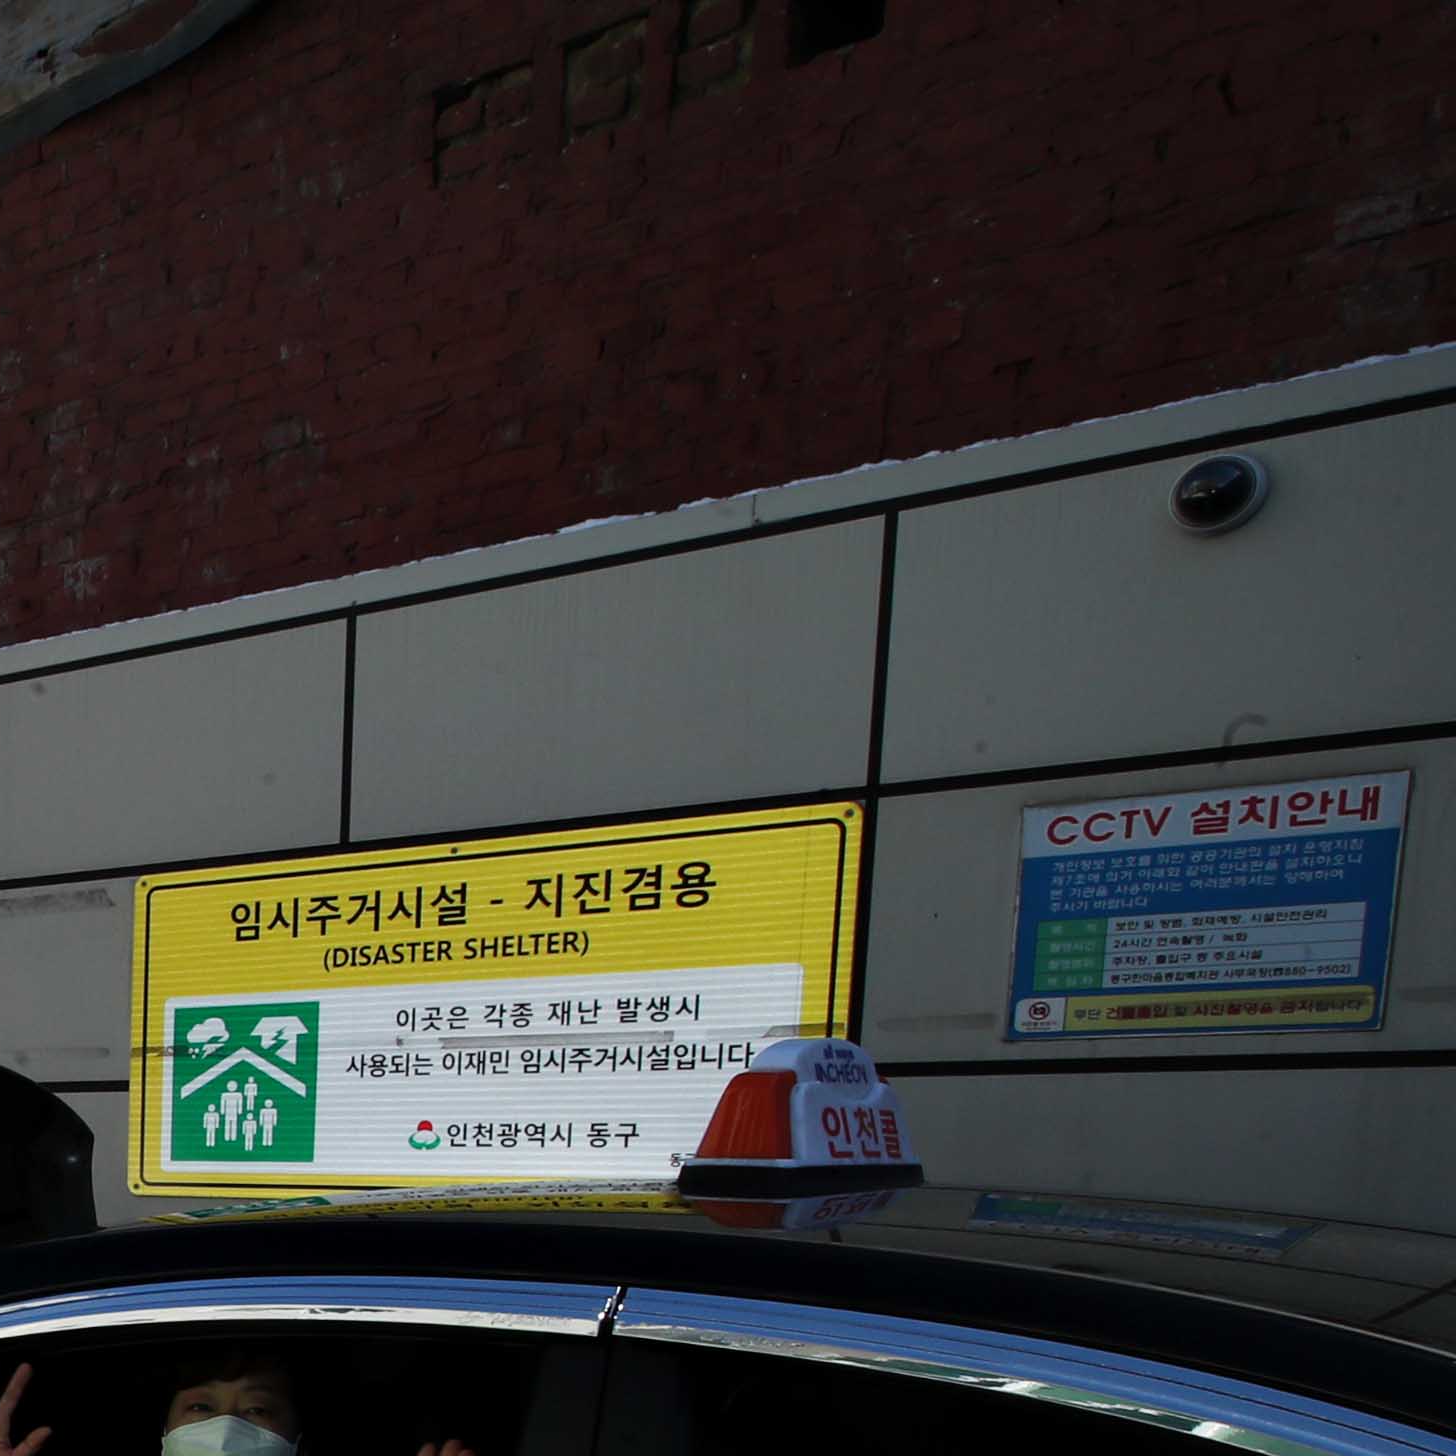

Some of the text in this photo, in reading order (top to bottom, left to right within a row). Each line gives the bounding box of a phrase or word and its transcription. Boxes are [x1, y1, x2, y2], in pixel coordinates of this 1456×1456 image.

[1046, 784, 1382, 845] CCTV 설치안내
[230, 881, 470, 942] 임시주거시설
[524, 860, 719, 921] 지진겸용
[322, 929, 591, 973] (DISASTER SHELTER)
[394, 993, 702, 1034] 이곳은 각종 재난 발생시
[345, 1042, 756, 1079] 사용되는 이재민 임시주거시설입니다
[446, 1121, 640, 1151] 인천광역시 동구
[822, 1106, 902, 1160] 인천콜
